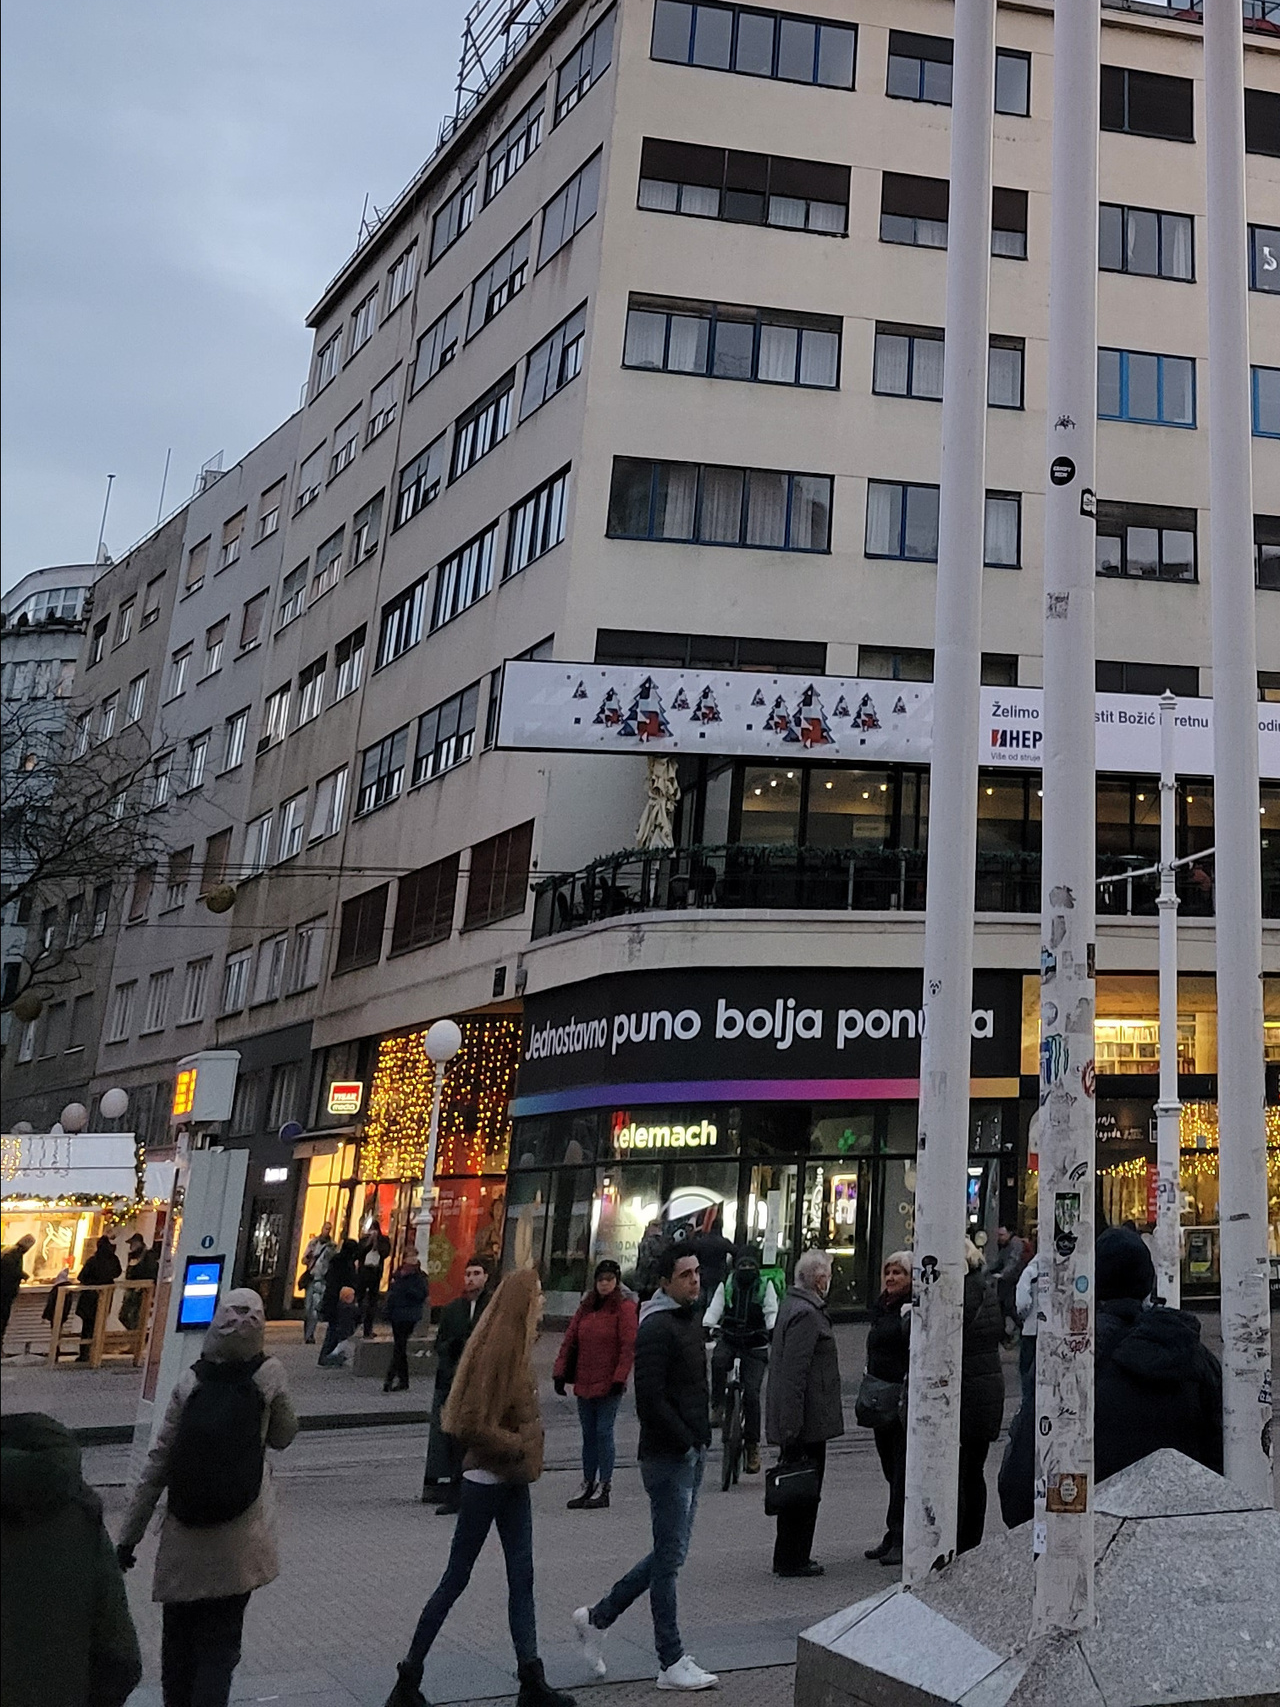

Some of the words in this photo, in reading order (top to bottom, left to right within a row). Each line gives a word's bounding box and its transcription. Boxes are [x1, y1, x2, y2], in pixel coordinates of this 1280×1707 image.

[991, 701, 1040, 719] Želimo
[1094, 710, 1114, 723] stit
[1118, 711, 1156, 725] Božić
[1174, 715, 1209, 728] retnu
[1009, 730, 1043, 749] HEP
[524, 1016, 608, 1061] Jednostavno
[611, 1009, 702, 1055] puno
[715, 998, 823, 1049] bolja
[837, 1009, 994, 1049] pona
[613, 1120, 718, 1149] telemach
